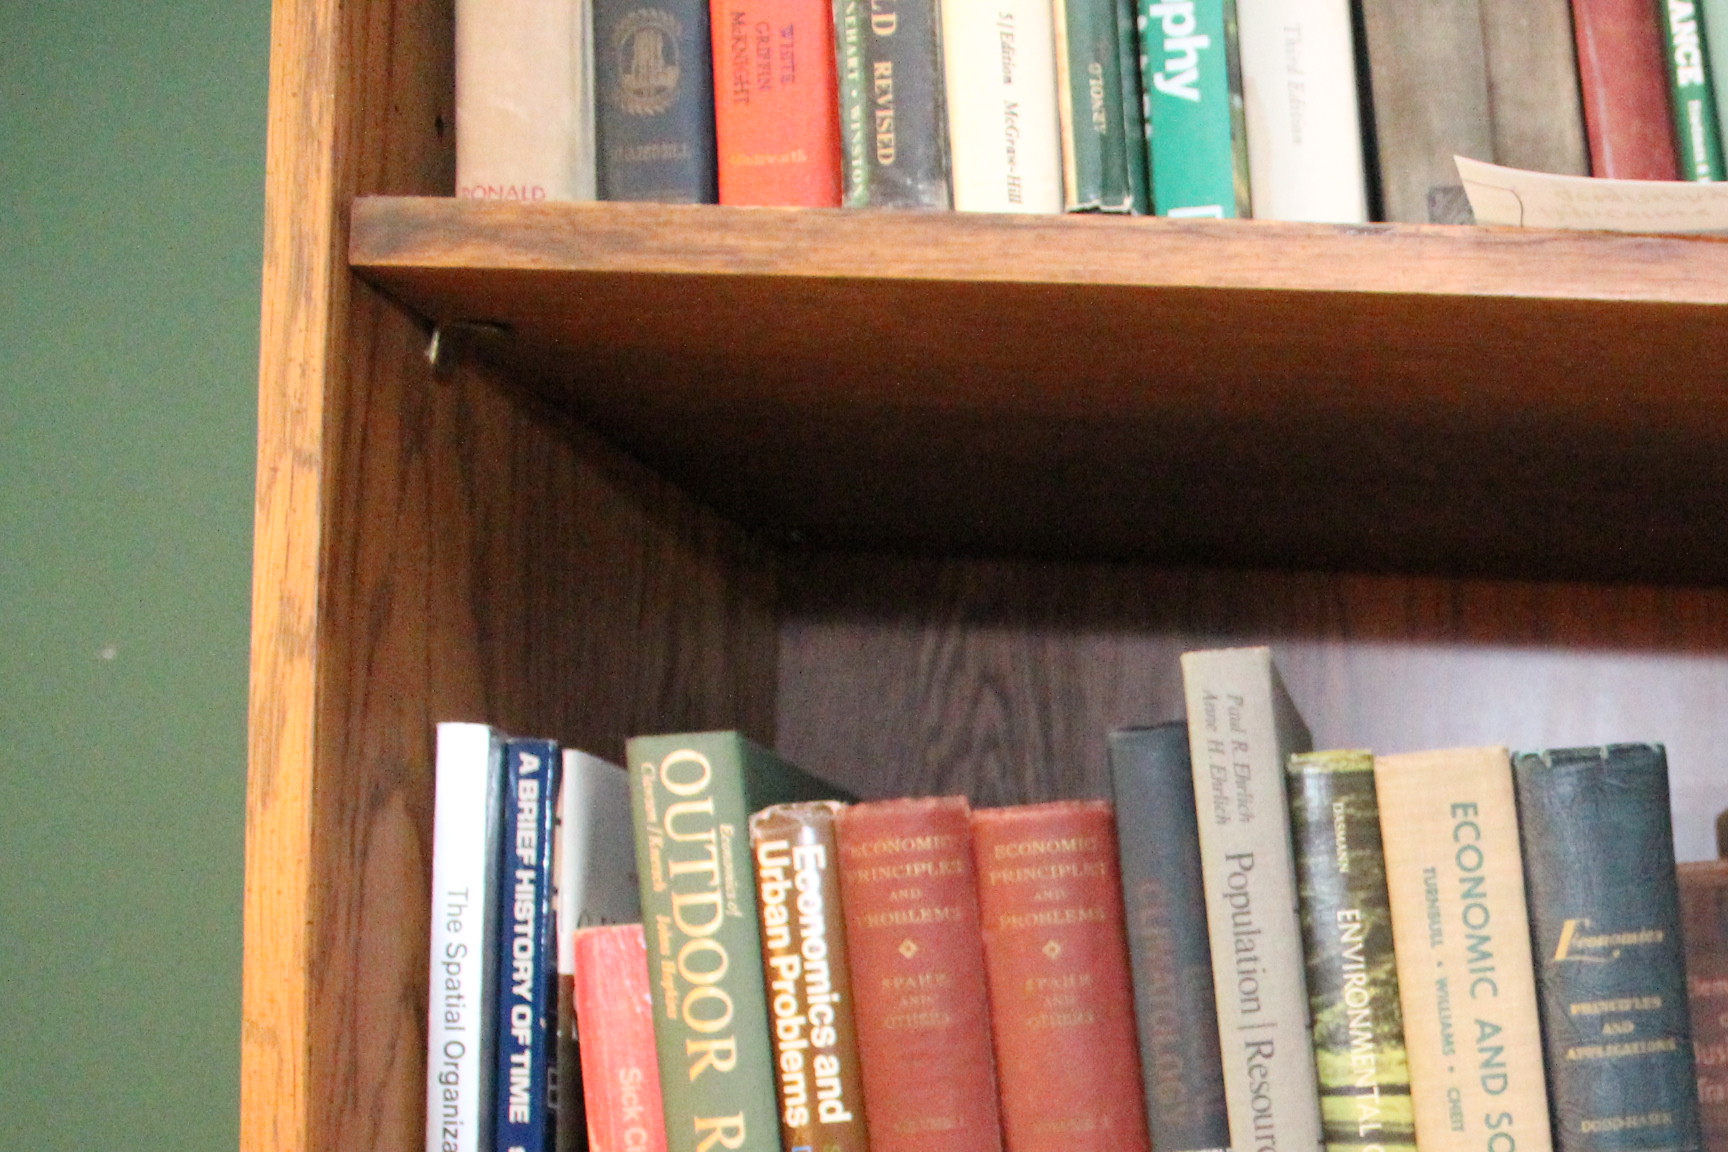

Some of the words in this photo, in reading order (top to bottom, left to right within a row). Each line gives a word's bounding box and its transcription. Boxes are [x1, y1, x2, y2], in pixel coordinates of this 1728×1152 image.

[850, 104, 864, 198] WINSTON
[873, 61, 897, 165] REVISED
[517, 751, 540, 775] A
[1209, 764, 1231, 825] Ehrlich
[1233, 763, 1256, 823] Ehrlich
[516, 779, 539, 865] BRIEF
[719, 823, 736, 899] Economics
[1332, 802, 1351, 874] DASMANN
[446, 887, 469, 933] The
[512, 869, 537, 1001] HISTORY
[660, 749, 738, 1082] OUTDOOR
[725, 900, 743, 917] of
[757, 838, 794, 949] Urban
[1222, 851, 1267, 1014] Population
[441, 942, 467, 1030] Spatial
[792, 843, 841, 1047] Economics
[1449, 801, 1498, 999] ECONOMIC
[1474, 1019, 1509, 1097] AND
[511, 1005, 533, 1046] OF
[768, 953, 810, 1129] Problems
[1336, 908, 1382, 1138] ENVIRONMENTAL
[1422, 867, 1444, 948] TURNBULL
[1434, 977, 1456, 1056] WILLIAMS
[1446, 1087, 1465, 1133] CHEIT
[1601, 1020, 1636, 1035] AND
[509, 1049, 532, 1123] TIME
[620, 1067, 644, 1122] Sick
[813, 1054, 853, 1124] and
